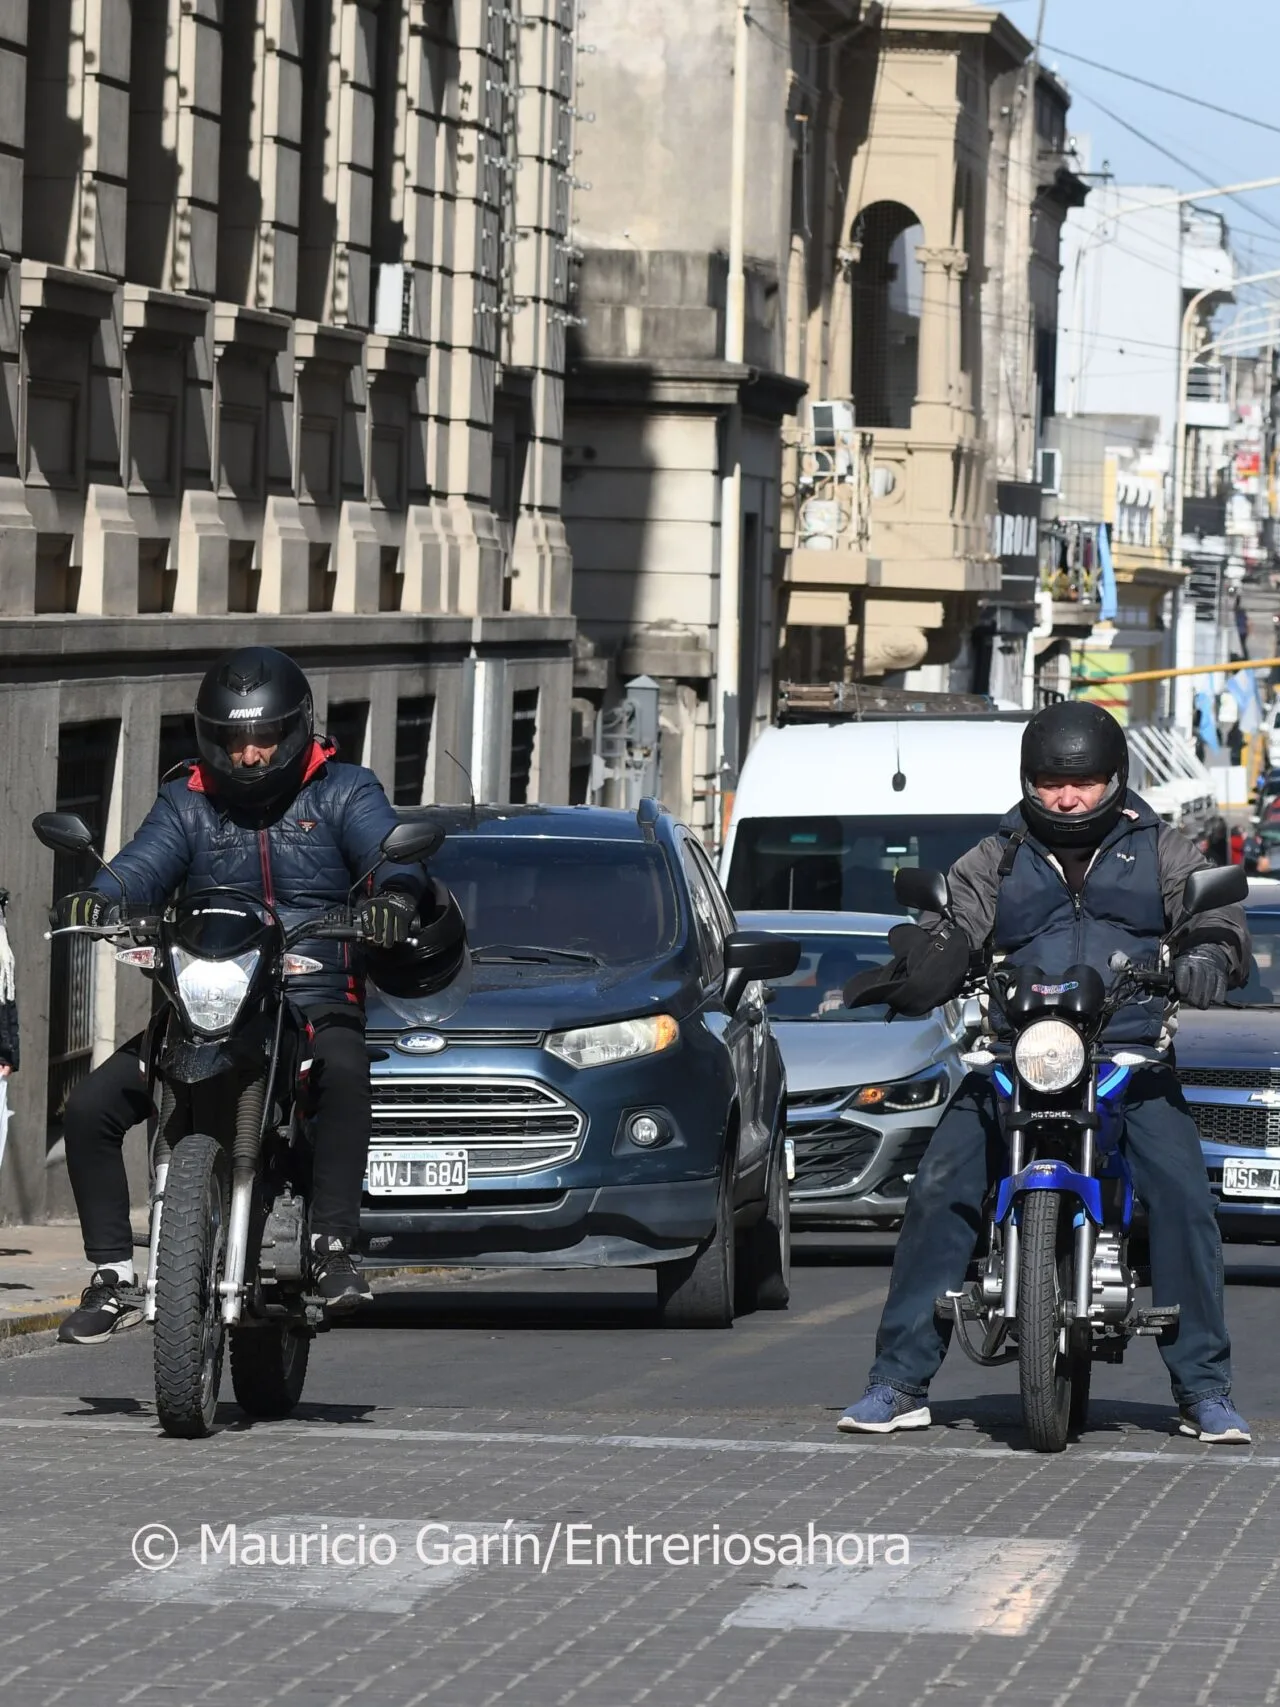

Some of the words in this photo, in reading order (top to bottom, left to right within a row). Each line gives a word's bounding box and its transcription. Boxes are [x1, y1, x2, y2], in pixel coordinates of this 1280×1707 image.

[229, 706, 264, 719] HAWK
[1030, 1110, 1071, 1119] MOTOMEL
[372, 1161, 411, 1187] MVJ
[425, 1161, 464, 1186] 684
[1226, 1167, 1259, 1189] MSC
